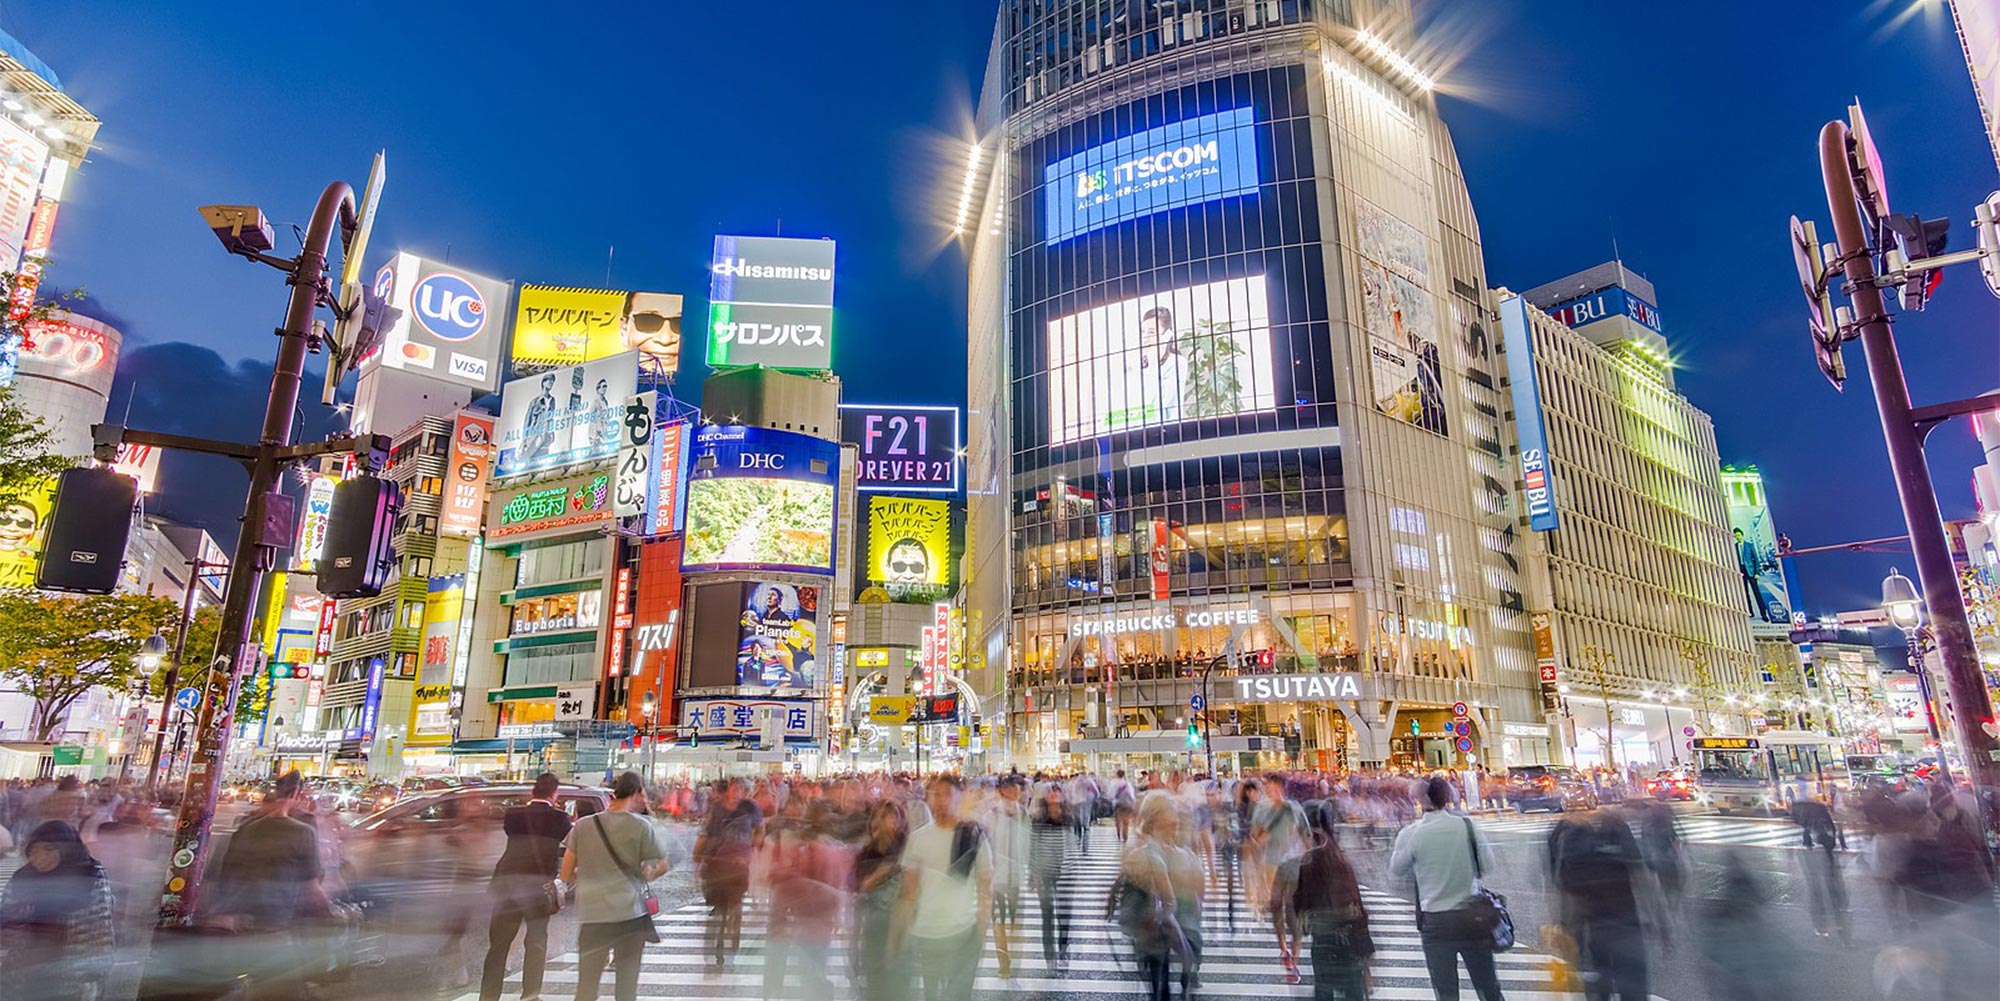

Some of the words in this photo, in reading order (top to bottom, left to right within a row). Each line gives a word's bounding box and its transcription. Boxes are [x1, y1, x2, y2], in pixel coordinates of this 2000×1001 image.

[1113, 140, 1218, 185] ITSCOM
[713, 257, 831, 281] Hisamitsu
[1627, 296, 1662, 332] SEIBU
[714, 321, 825, 347] サロンパス
[454, 358, 485, 376] VISA
[504, 430, 521, 443] ALL
[547, 417, 571, 432] BEST
[865, 415, 927, 455] F21
[617, 396, 651, 512] もんじゃ
[739, 453, 784, 470] DHC
[655, 428, 677, 528] 三千里薬品
[857, 459, 926, 480] OREVER
[932, 461, 951, 481] 21
[1522, 449, 1549, 517] SEIBU
[755, 625, 801, 639] Planets
[1072, 614, 1175, 637] STARBUCKS
[1186, 609, 1259, 628] COFFEE
[1238, 676, 1360, 700] TSUTAYA
[688, 706, 806, 729] 大盛堂店
[277, 733, 325, 749] グルメタウン
